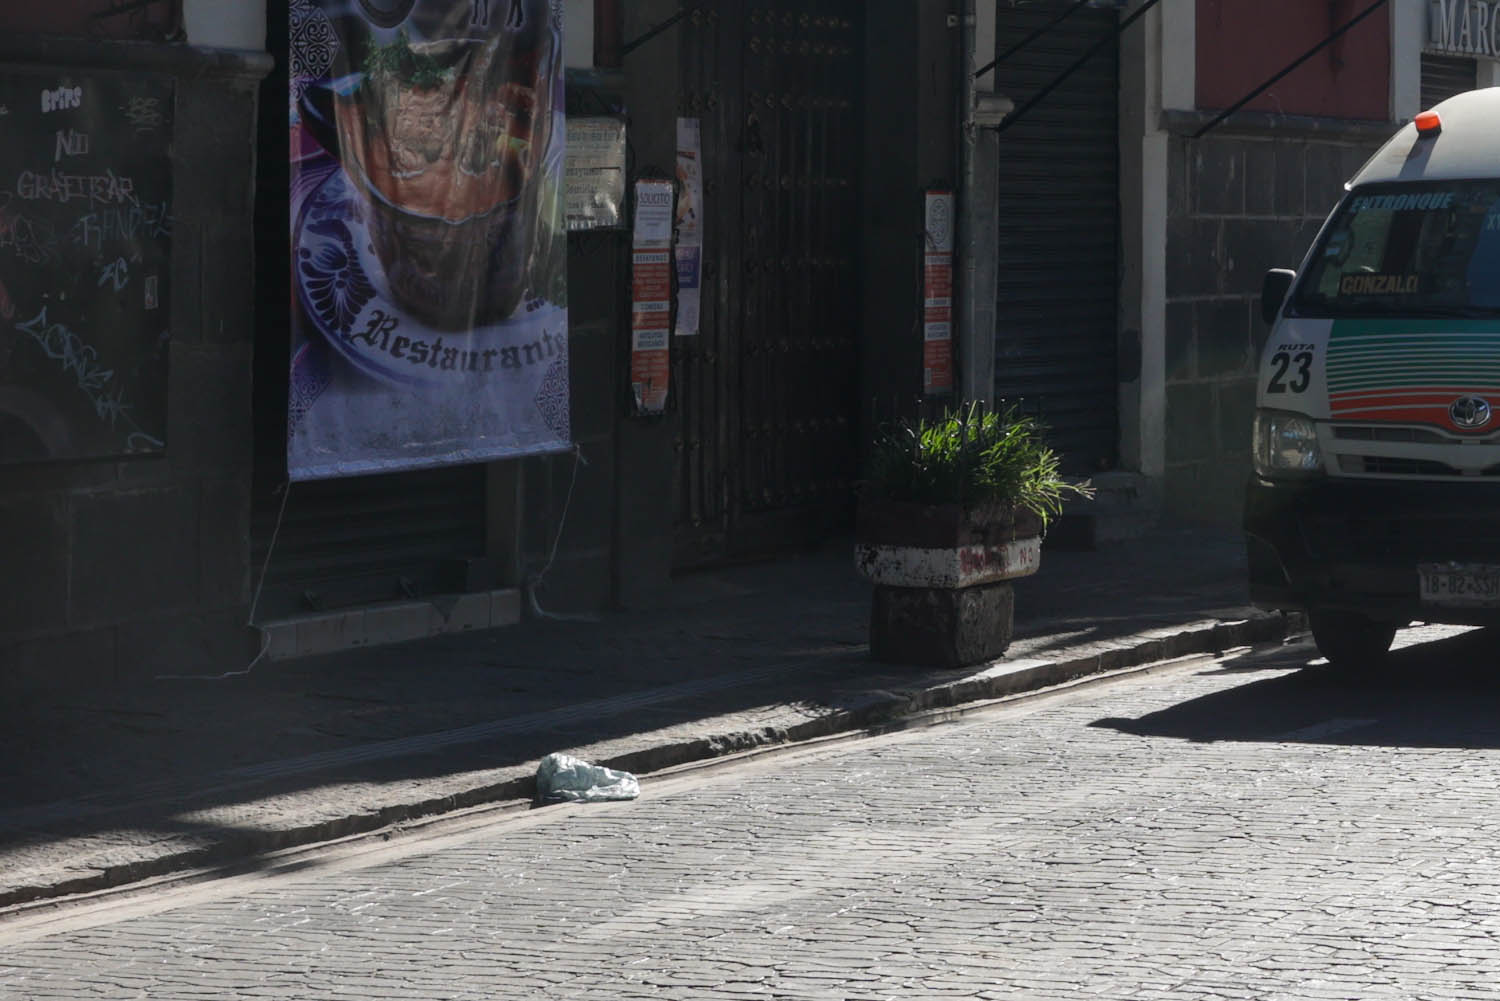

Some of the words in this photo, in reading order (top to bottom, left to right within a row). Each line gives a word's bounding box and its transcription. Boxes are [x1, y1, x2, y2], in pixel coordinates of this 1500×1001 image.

[1341, 274, 1419, 295] GONZALO
[351, 309, 567, 372] Restaurante
[1278, 343, 1315, 351] RUTA
[1266, 351, 1313, 394] 23
